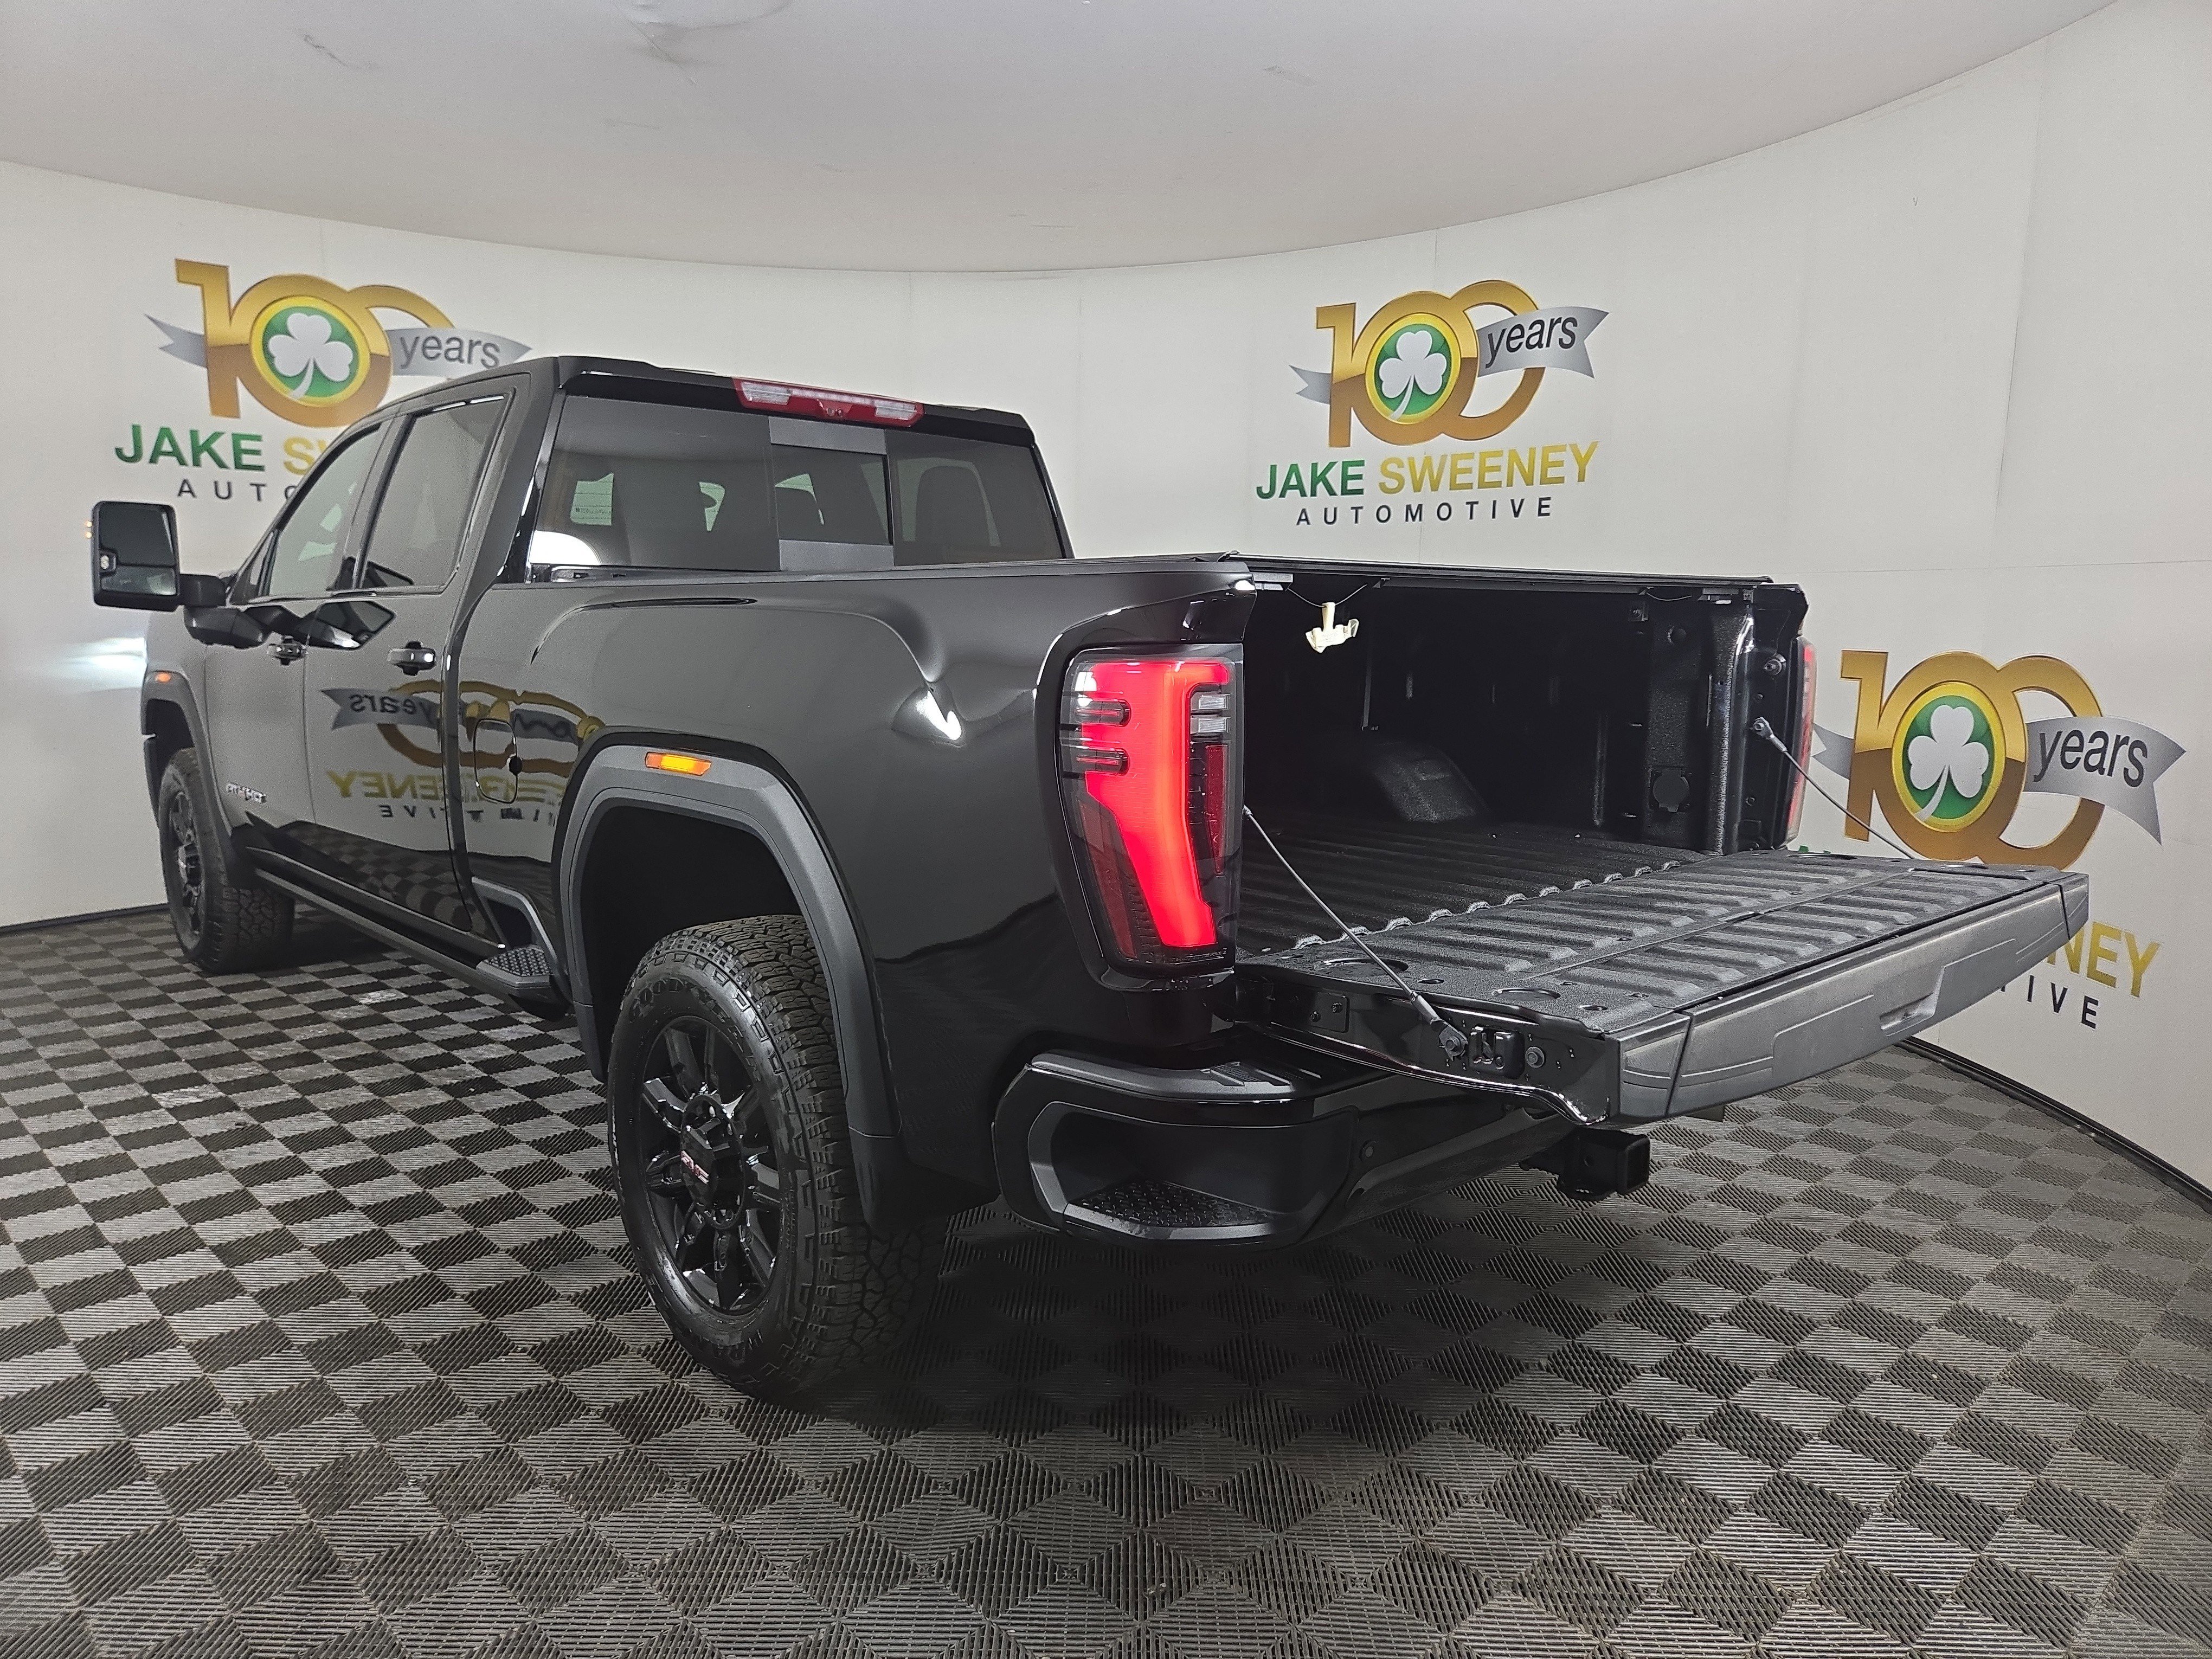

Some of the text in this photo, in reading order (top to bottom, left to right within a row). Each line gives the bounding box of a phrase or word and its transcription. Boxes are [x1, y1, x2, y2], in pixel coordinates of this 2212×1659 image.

[398, 334, 501, 369] years
[1485, 313, 1578, 369] years
[115, 424, 266, 472] JAKE
[1256, 441, 1600, 500] JAKE SWEENEY
[1296, 497, 1552, 526] AUTOMOTIVE
[2033, 729, 2148, 788] years
